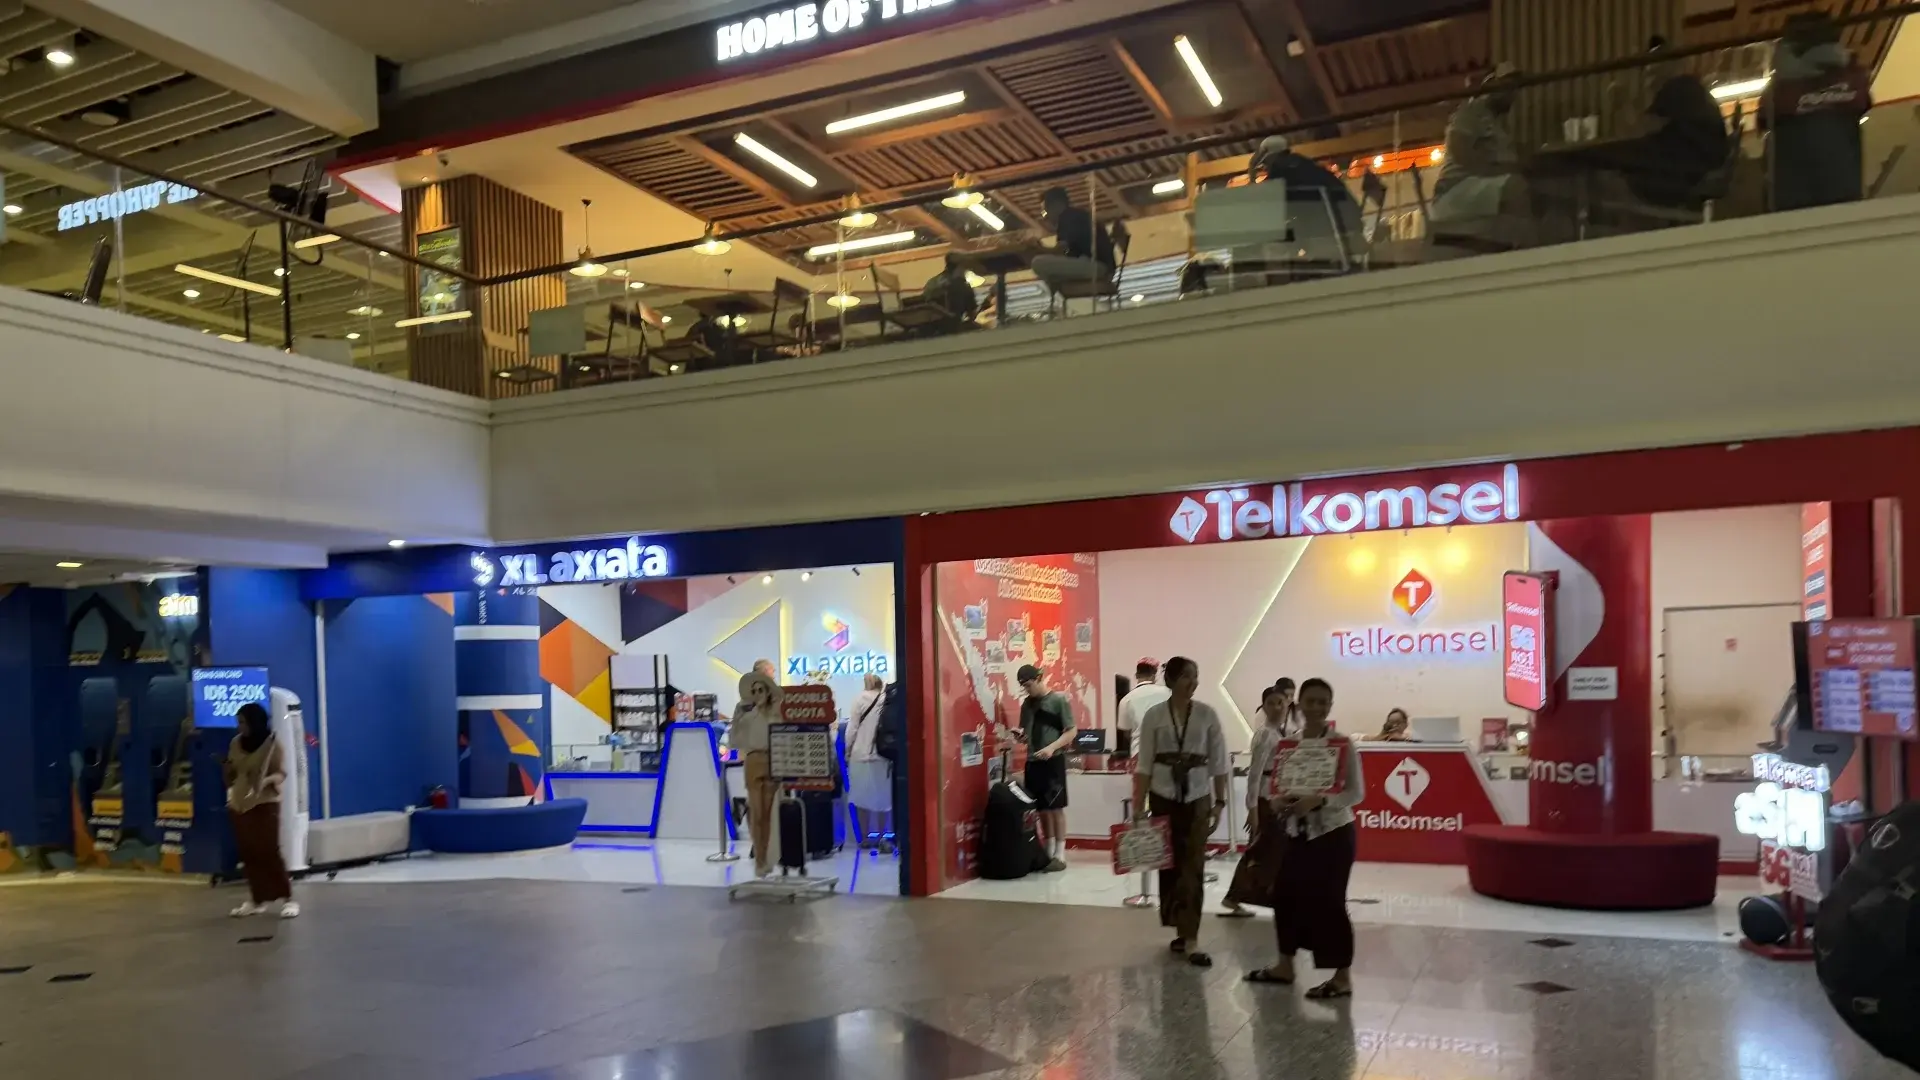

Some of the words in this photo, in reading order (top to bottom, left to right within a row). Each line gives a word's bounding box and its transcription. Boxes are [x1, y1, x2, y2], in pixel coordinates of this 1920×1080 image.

[717, 3, 818, 61] HOME
[822, 0, 870, 32] OF
[1204, 463, 1519, 540] Telkomsel
[499, 553, 548, 586] XL
[550, 536, 669, 582] axiata
[1331, 624, 1498, 657] Telkomsel
[787, 655, 809, 675] XL
[818, 649, 888, 674] axiata
[204, 684, 228, 700] IDR
[229, 684, 266, 700] 250K
[784, 692, 829, 703] DOUBLE
[784, 707, 827, 718] QUOTA
[1528, 755, 1605, 786] msel
[1356, 809, 1463, 831] Telkomsel
